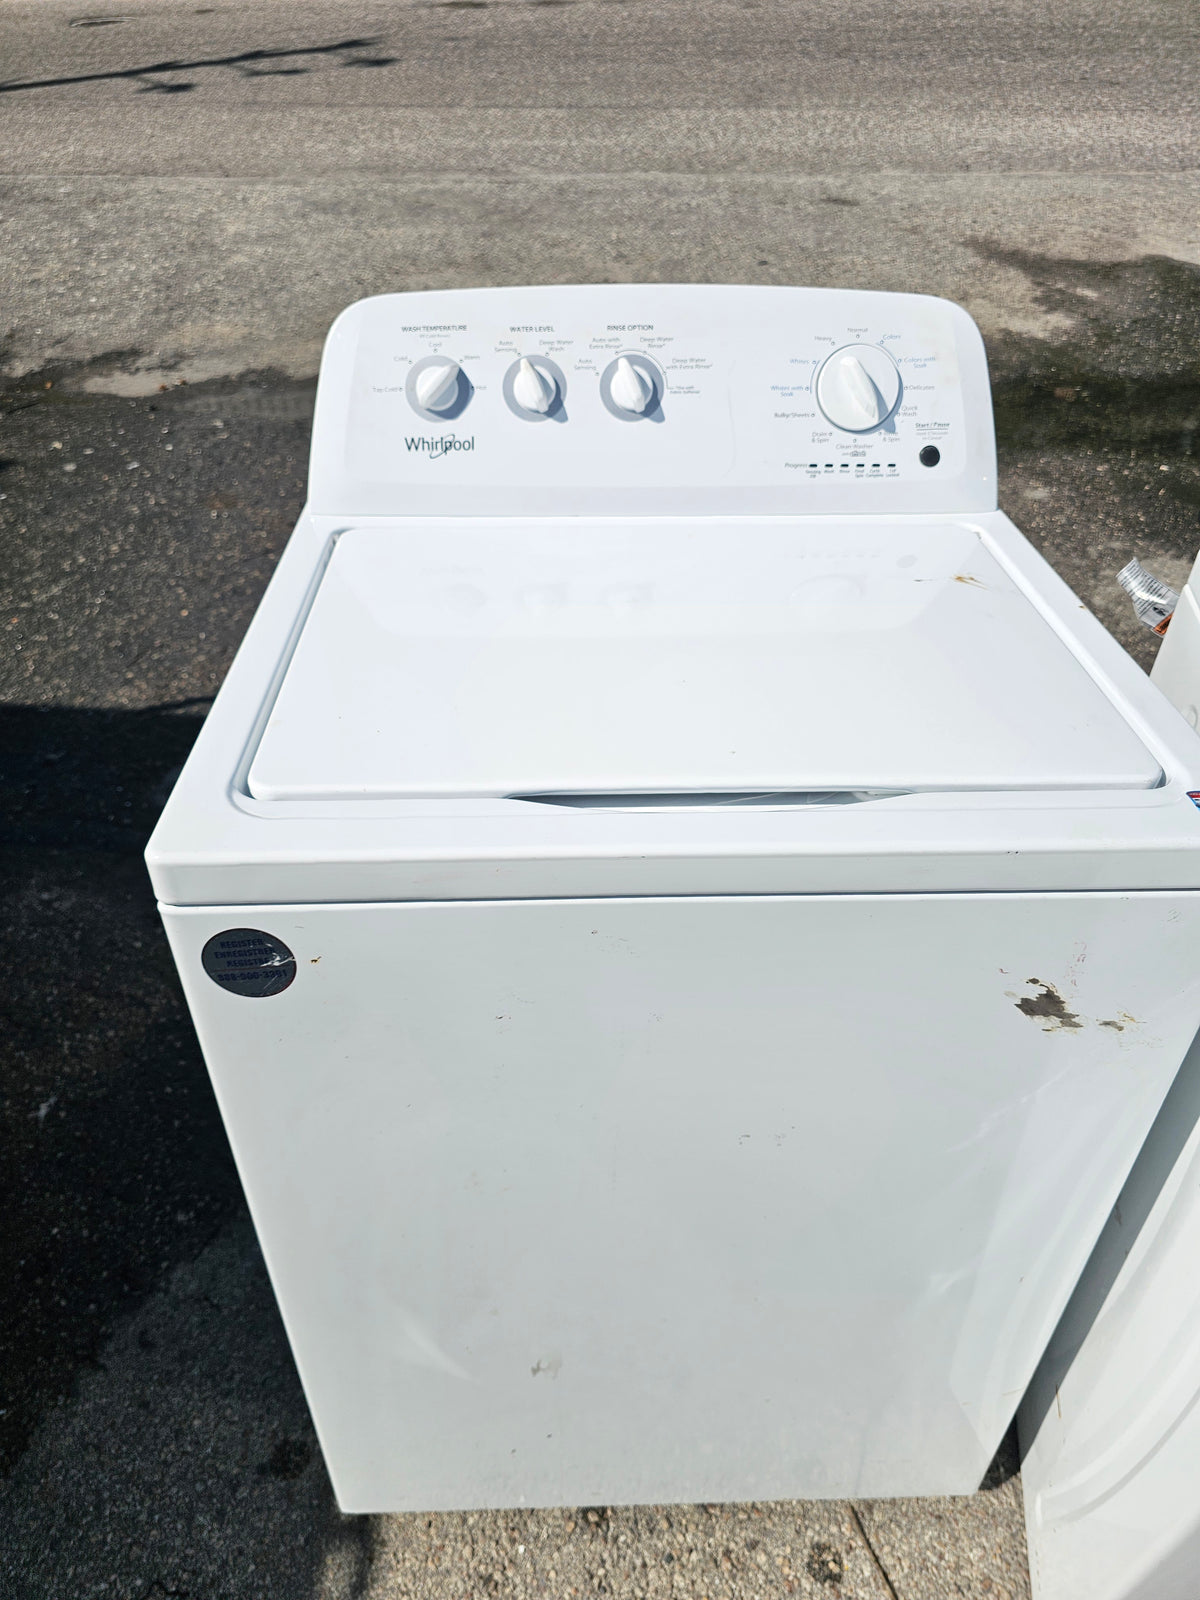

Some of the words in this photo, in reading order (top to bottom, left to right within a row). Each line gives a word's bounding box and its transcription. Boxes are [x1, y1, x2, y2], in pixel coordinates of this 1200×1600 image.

[422, 324, 467, 332] TEMPERATURE
[404, 435, 475, 456] Whirlpool
[219, 939, 265, 949] REGISTER
